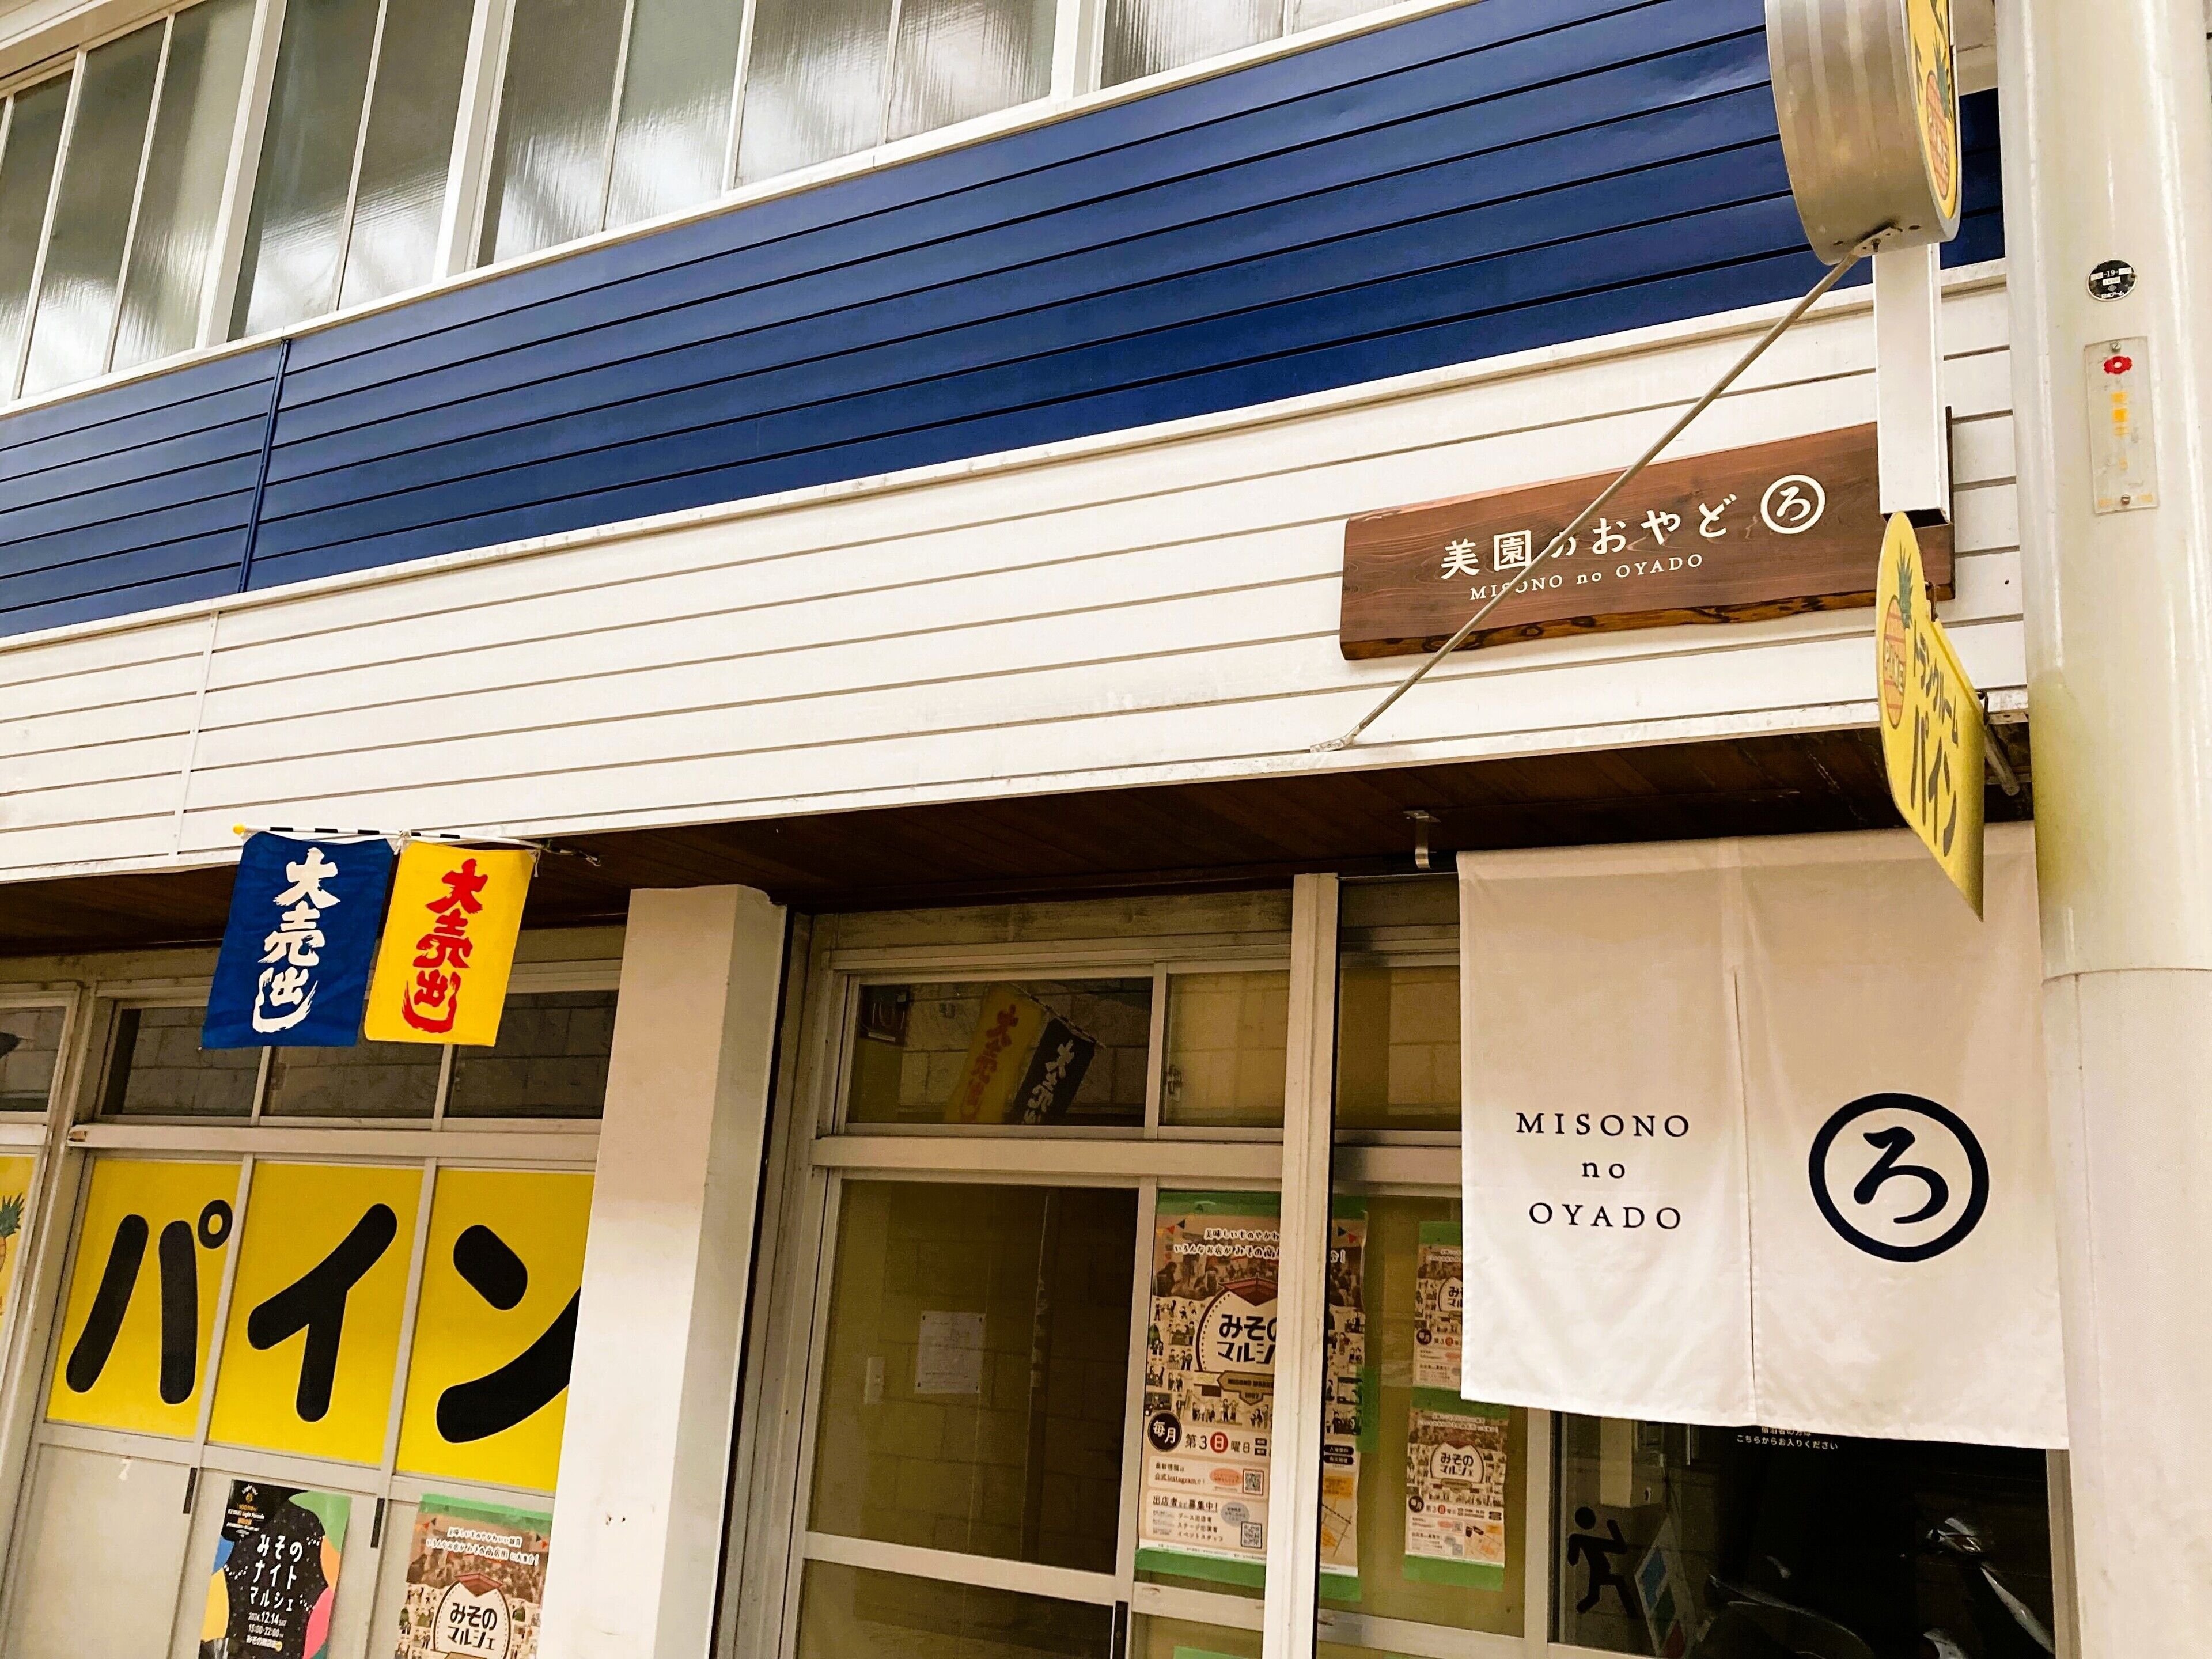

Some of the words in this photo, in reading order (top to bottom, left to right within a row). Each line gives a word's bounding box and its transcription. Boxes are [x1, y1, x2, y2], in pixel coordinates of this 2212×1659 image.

[1576, 570, 1603, 585] no
[1616, 554, 1703, 579] OYADO
[1910, 705, 1957, 857] パイン
[1516, 1112, 1691, 1138] MISONO
[1581, 1161, 1626, 1179] no
[1529, 1202, 1682, 1230] OYADO
[66, 1200, 581, 1444] パイン
[1153, 1421, 1176, 1444] 毎月
[1737, 1434, 1838, 1450] こちらからお入りください
[1440, 1452, 1474, 1467] みその
[256, 1533, 303, 1563] みその
[253, 1559, 297, 1590] ナイト
[250, 1586, 294, 1612] マルシェ
[449, 1602, 498, 1631] みその
[447, 1625, 497, 1651] マルシェ
